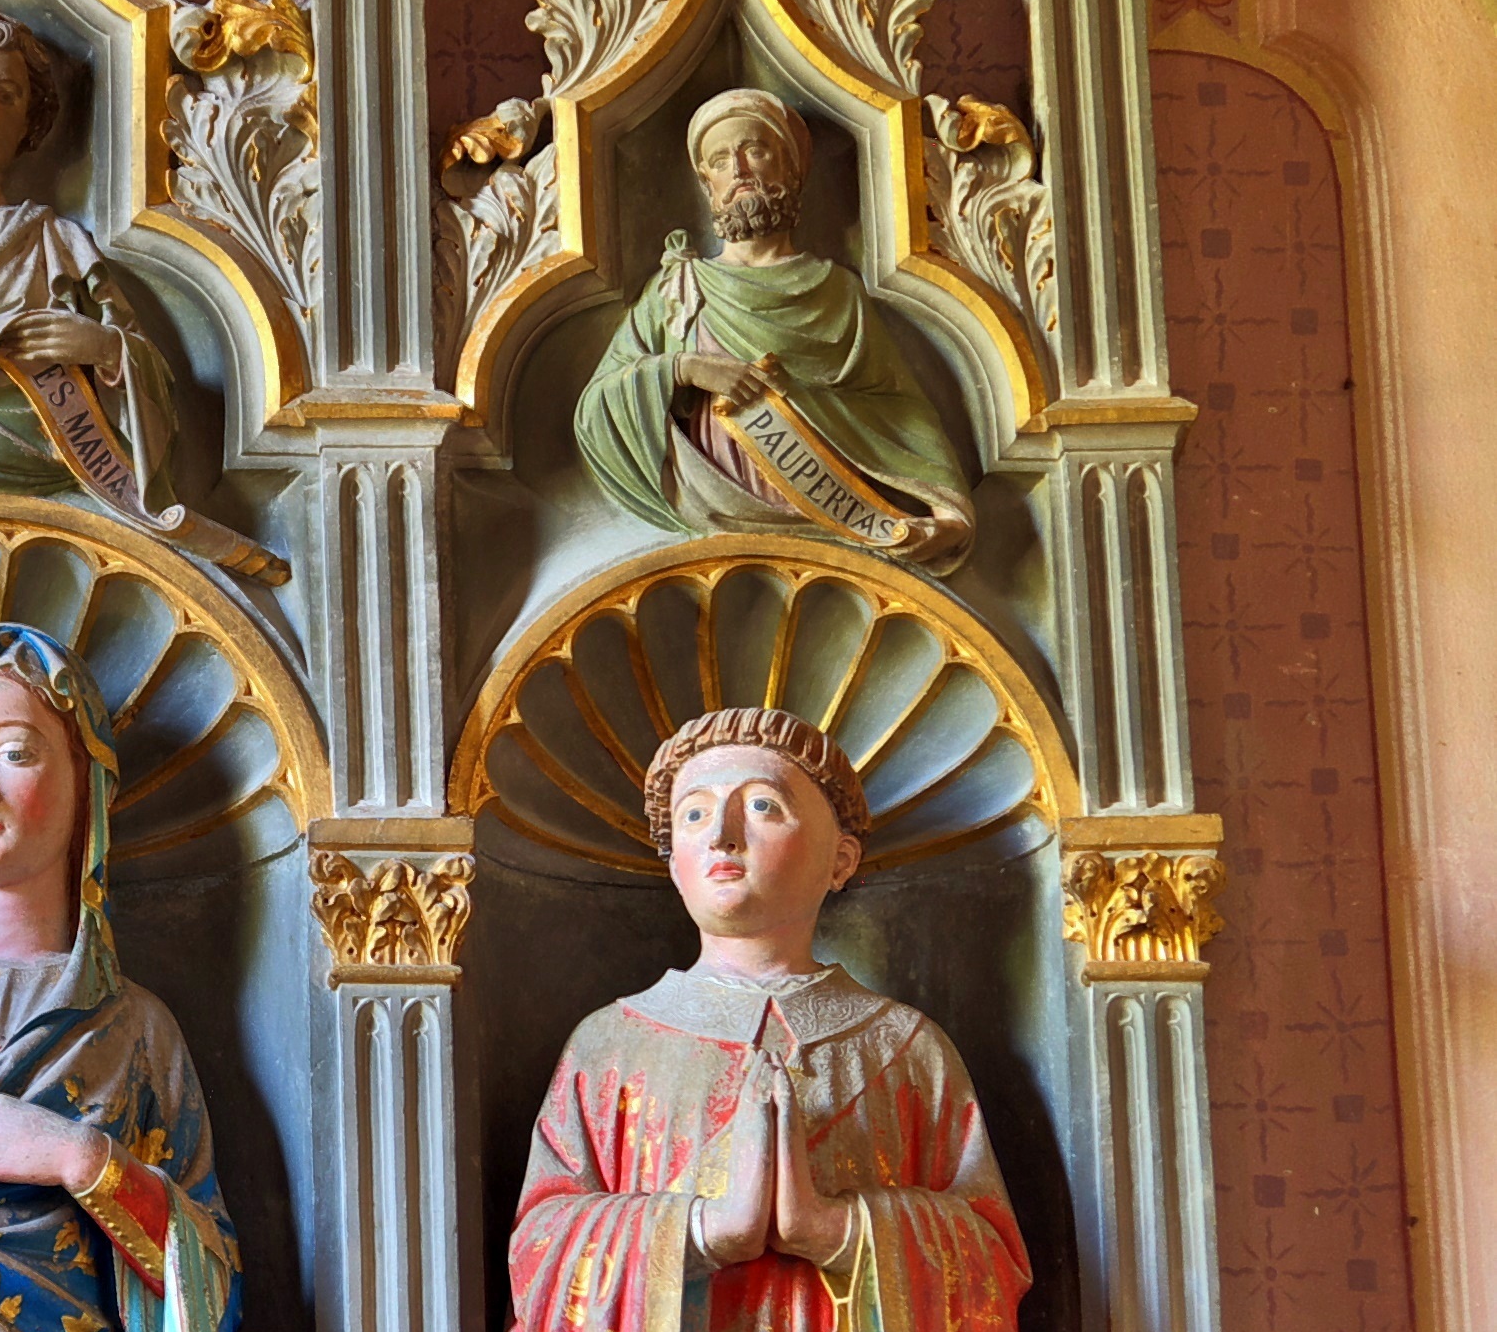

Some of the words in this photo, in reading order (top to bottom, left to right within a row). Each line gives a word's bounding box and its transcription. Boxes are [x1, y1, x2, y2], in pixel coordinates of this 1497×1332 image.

[32, 363, 75, 407] ES
[64, 409, 130, 499] MARIA
[744, 409, 895, 539] PAUPERTAS
